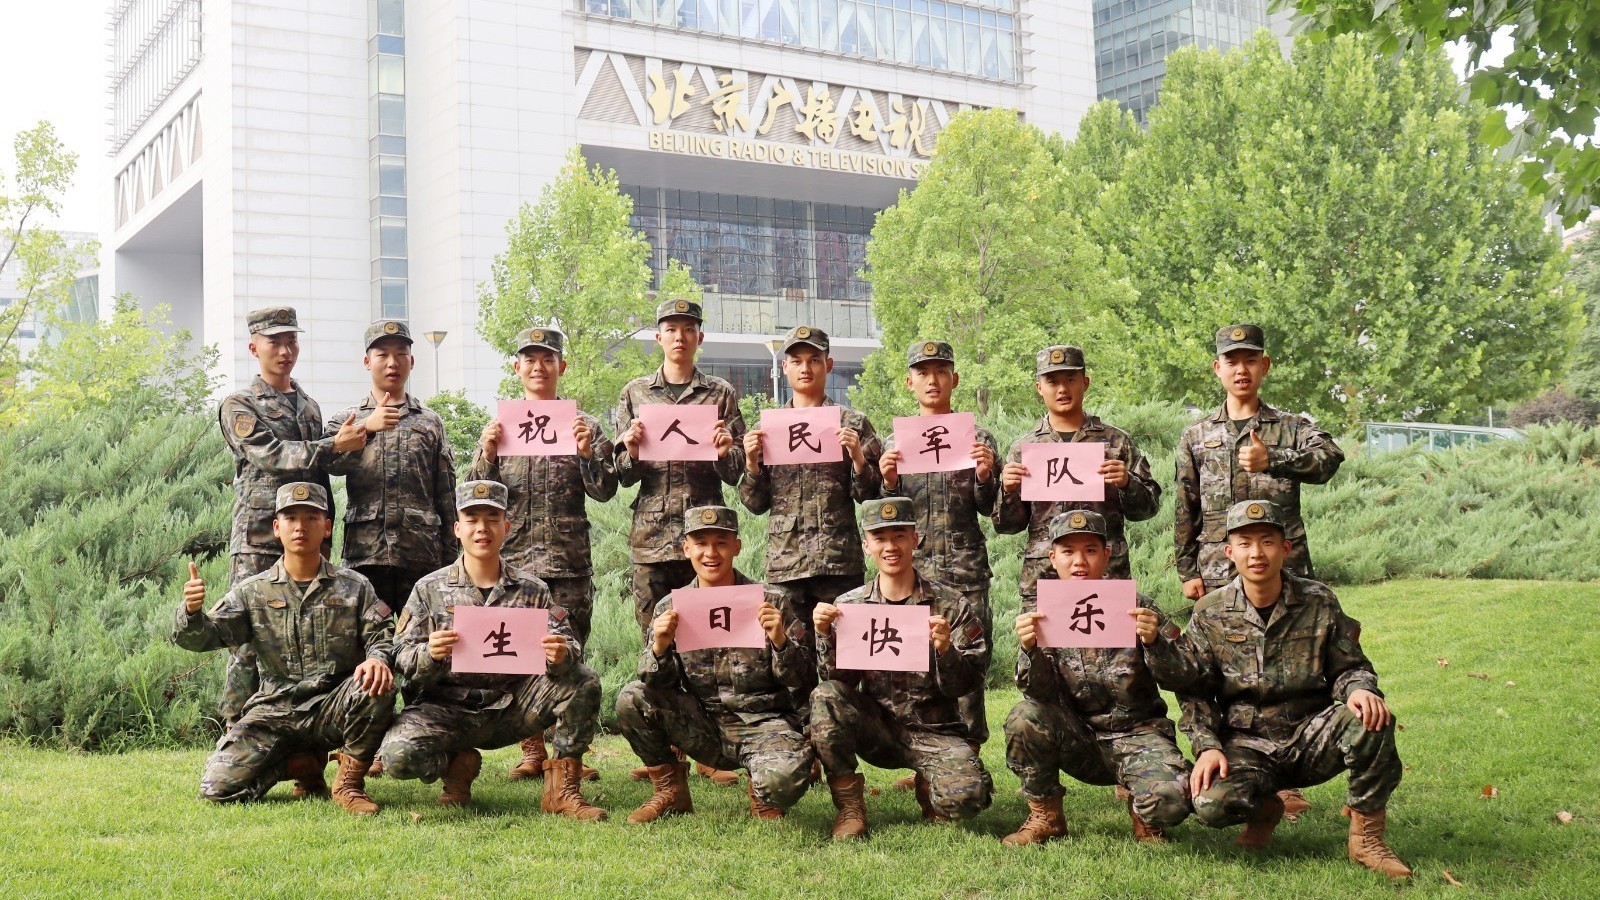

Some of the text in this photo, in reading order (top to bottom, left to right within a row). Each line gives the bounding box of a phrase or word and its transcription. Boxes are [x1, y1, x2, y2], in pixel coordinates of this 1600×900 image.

[649, 130, 724, 156] BEIJING
[728, 139, 788, 163] RADIO
[792, 149, 807, 166] &
[808, 150, 906, 178] TELEVISION
[518, 409, 558, 445] 祝
[660, 418, 700, 445] 人
[788, 422, 822, 454] 民
[919, 425, 952, 464] 军
[1046, 457, 1084, 488] 队
[709, 606, 732, 633] 日
[1068, 593, 1106, 635] 乐
[482, 621, 518, 658] 生
[861, 617, 903, 657] 快
